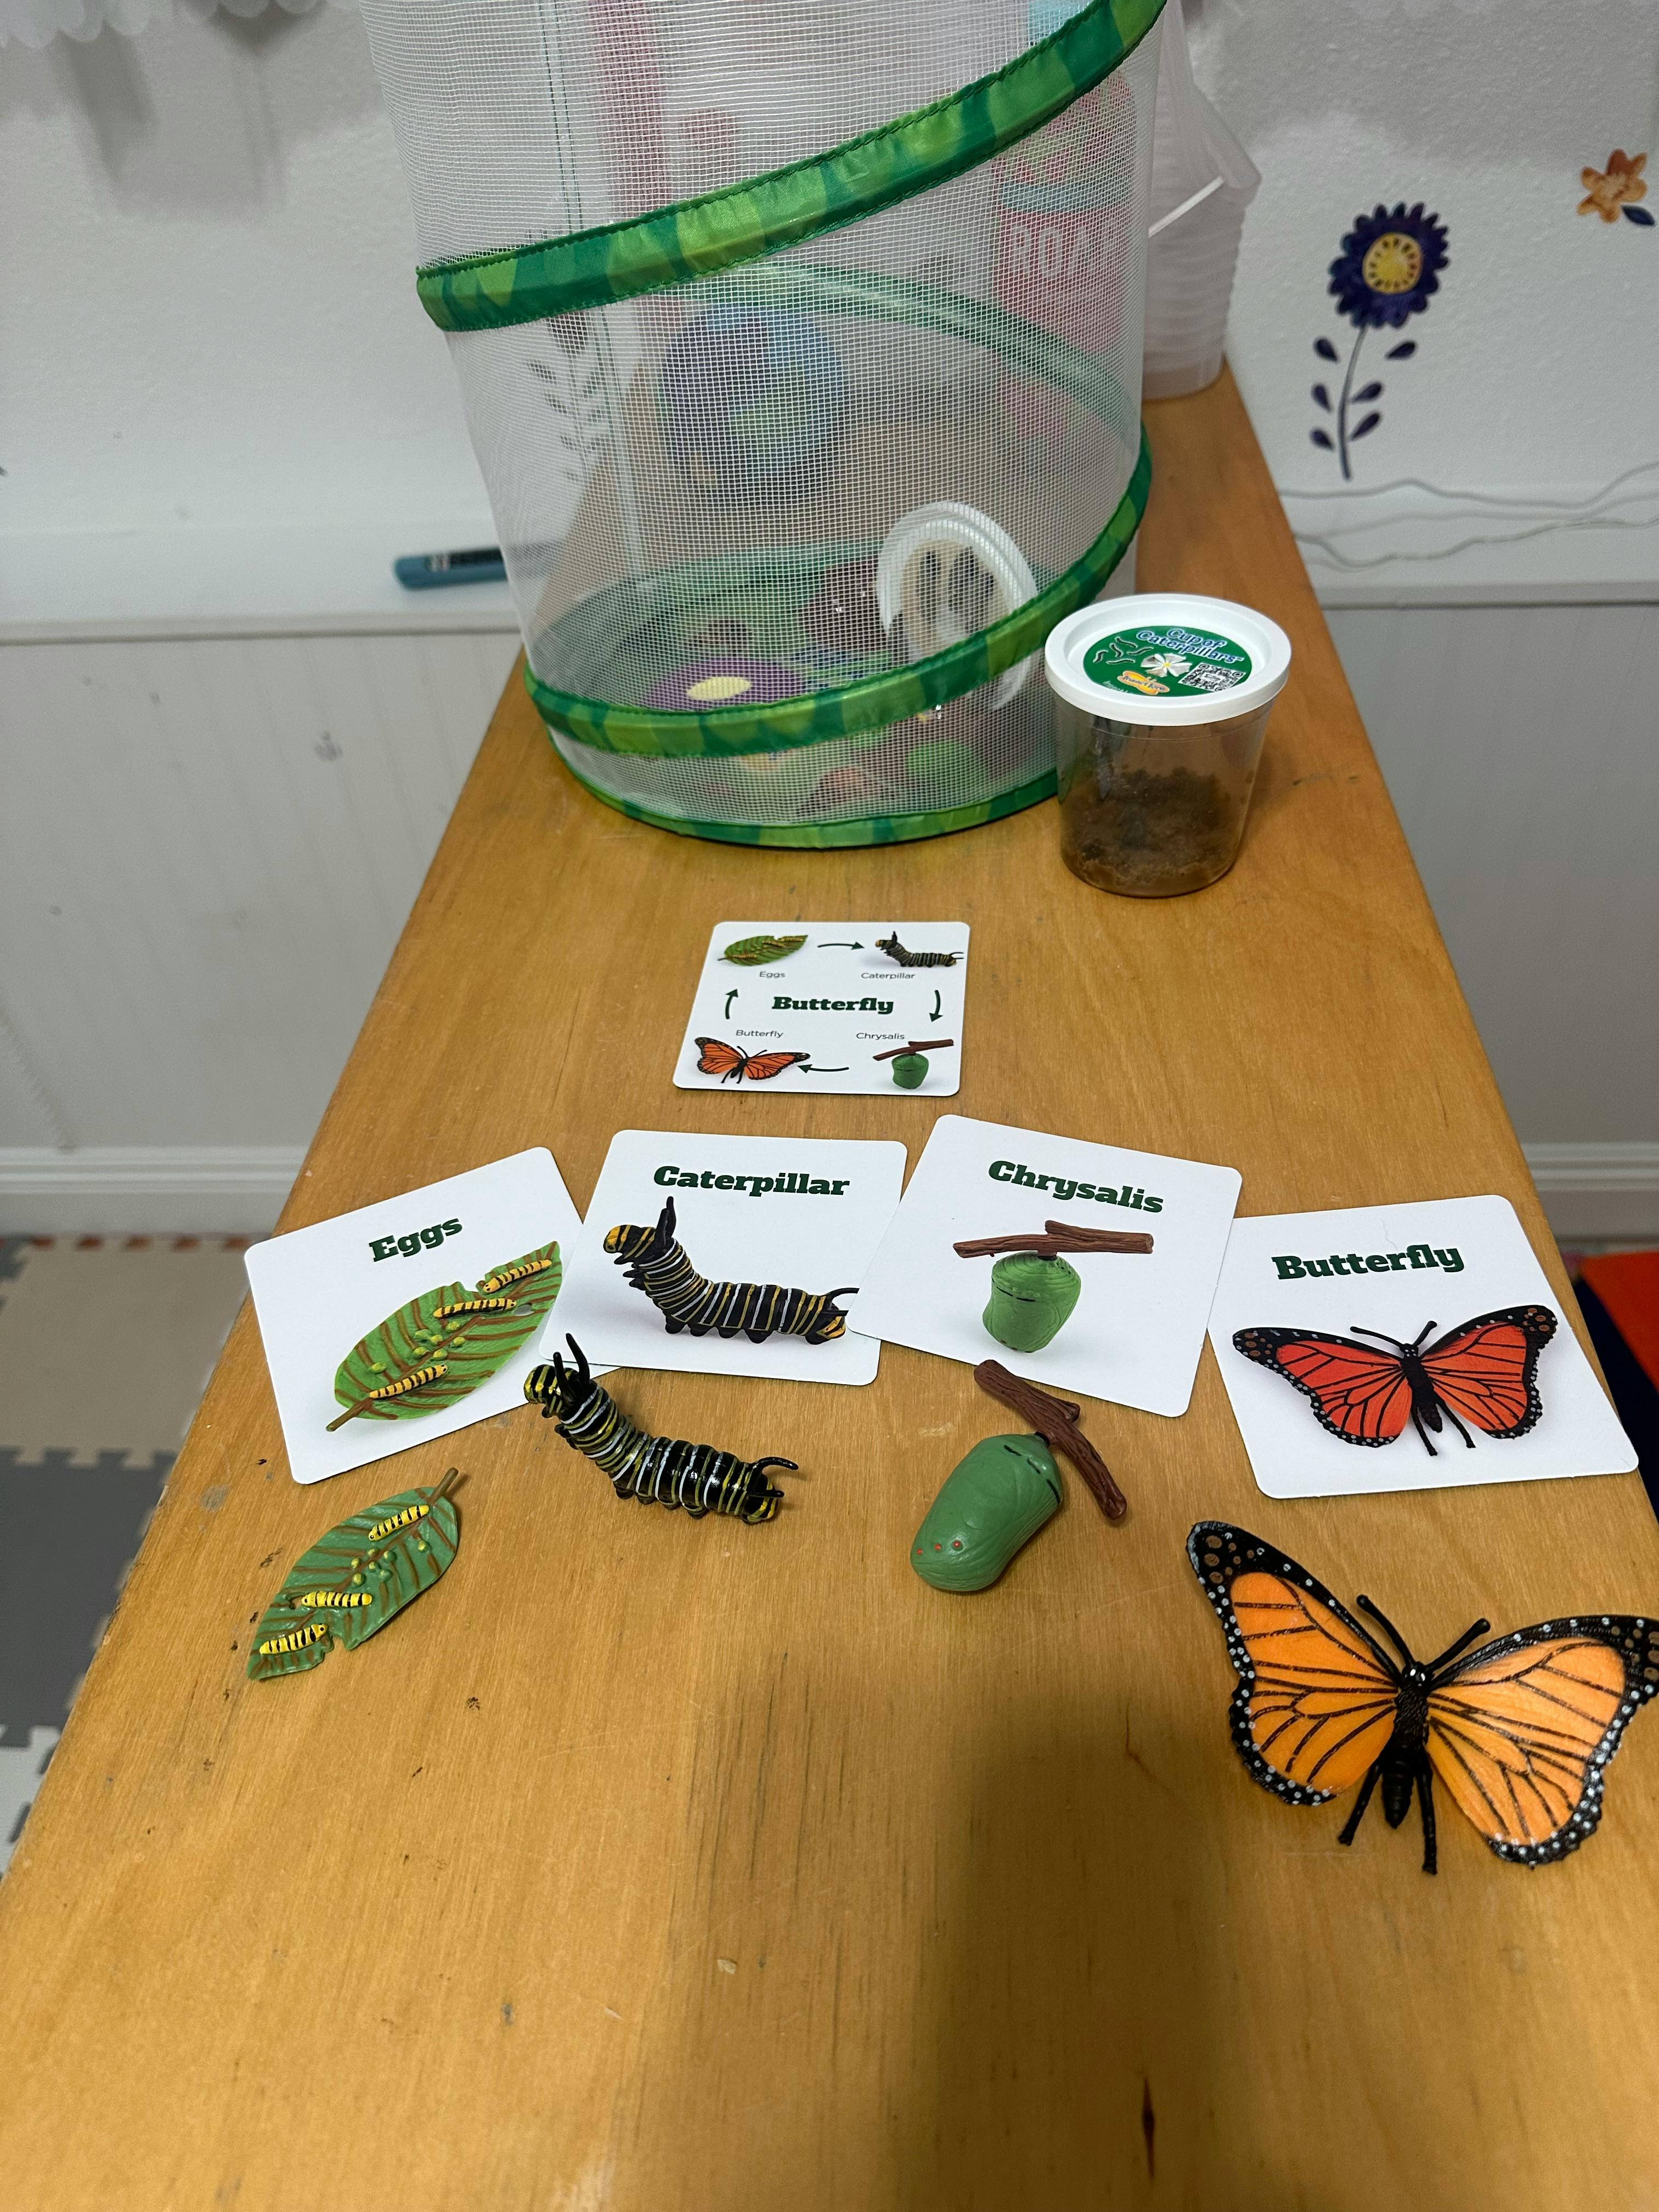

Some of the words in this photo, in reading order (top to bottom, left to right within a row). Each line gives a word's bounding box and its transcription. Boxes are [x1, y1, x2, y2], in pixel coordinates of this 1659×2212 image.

[1136, 630, 1238, 663] Caterpillars
[1167, 629, 1203, 645] Cup
[1201, 640, 1227, 648] of
[759, 971, 786, 979] Eggs
[861, 972, 916, 980] Caterpillar
[771, 996, 894, 1015] Butterfly
[736, 1029, 784, 1039] Butterfly
[653, 1166, 850, 1197] Caterpillar
[988, 1160, 1164, 1213] Chrysalis
[369, 1218, 462, 1262] Eggs
[1271, 1244, 1464, 1280] Butterfly
